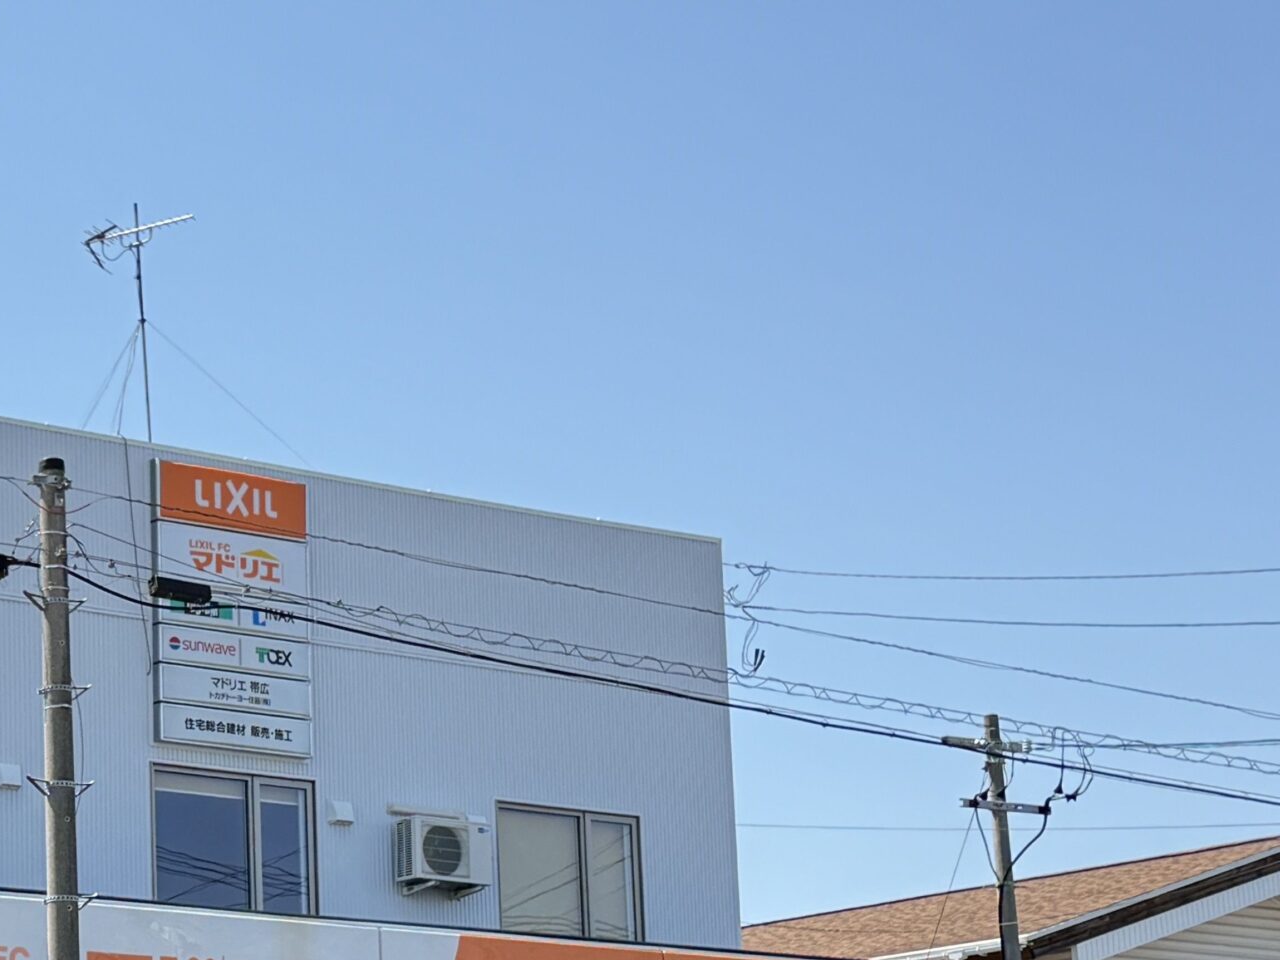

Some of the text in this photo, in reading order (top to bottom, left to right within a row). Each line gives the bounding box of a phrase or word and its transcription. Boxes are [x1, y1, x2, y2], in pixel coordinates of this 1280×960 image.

[195, 479, 277, 519] LIXIL
[189, 539, 231, 553] LIXIL FC
[189, 550, 281, 584] マドリエ
[182, 639, 236, 657] sunwave
[255, 646, 293, 668] TOEX
[211, 677, 270, 695] マドリエ 帯広
[185, 717, 293, 742] 住宅総合建材 販売・施工
